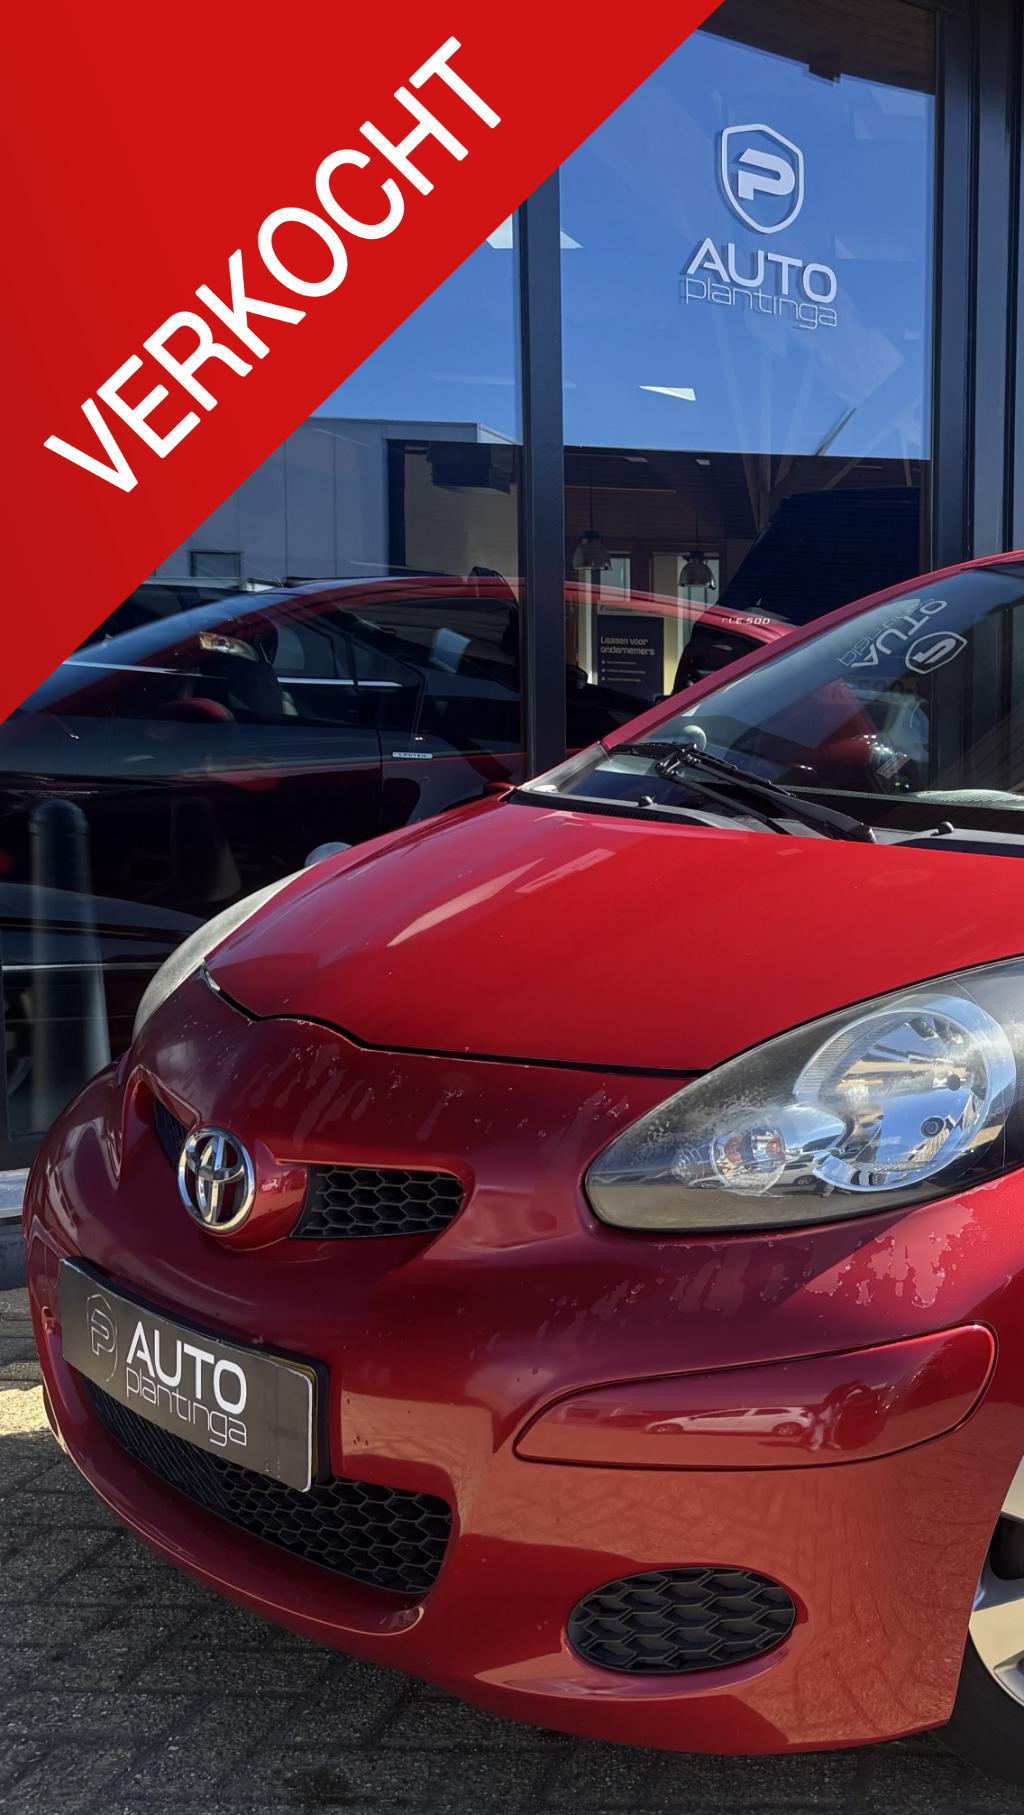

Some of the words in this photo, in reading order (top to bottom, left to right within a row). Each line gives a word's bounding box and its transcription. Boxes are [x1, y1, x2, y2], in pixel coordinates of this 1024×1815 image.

[685, 277, 838, 330] plantinga
[686, 237, 838, 304] AUTO
[126, 1320, 248, 1416] AUTO
[126, 1366, 248, 1448] plantinga
